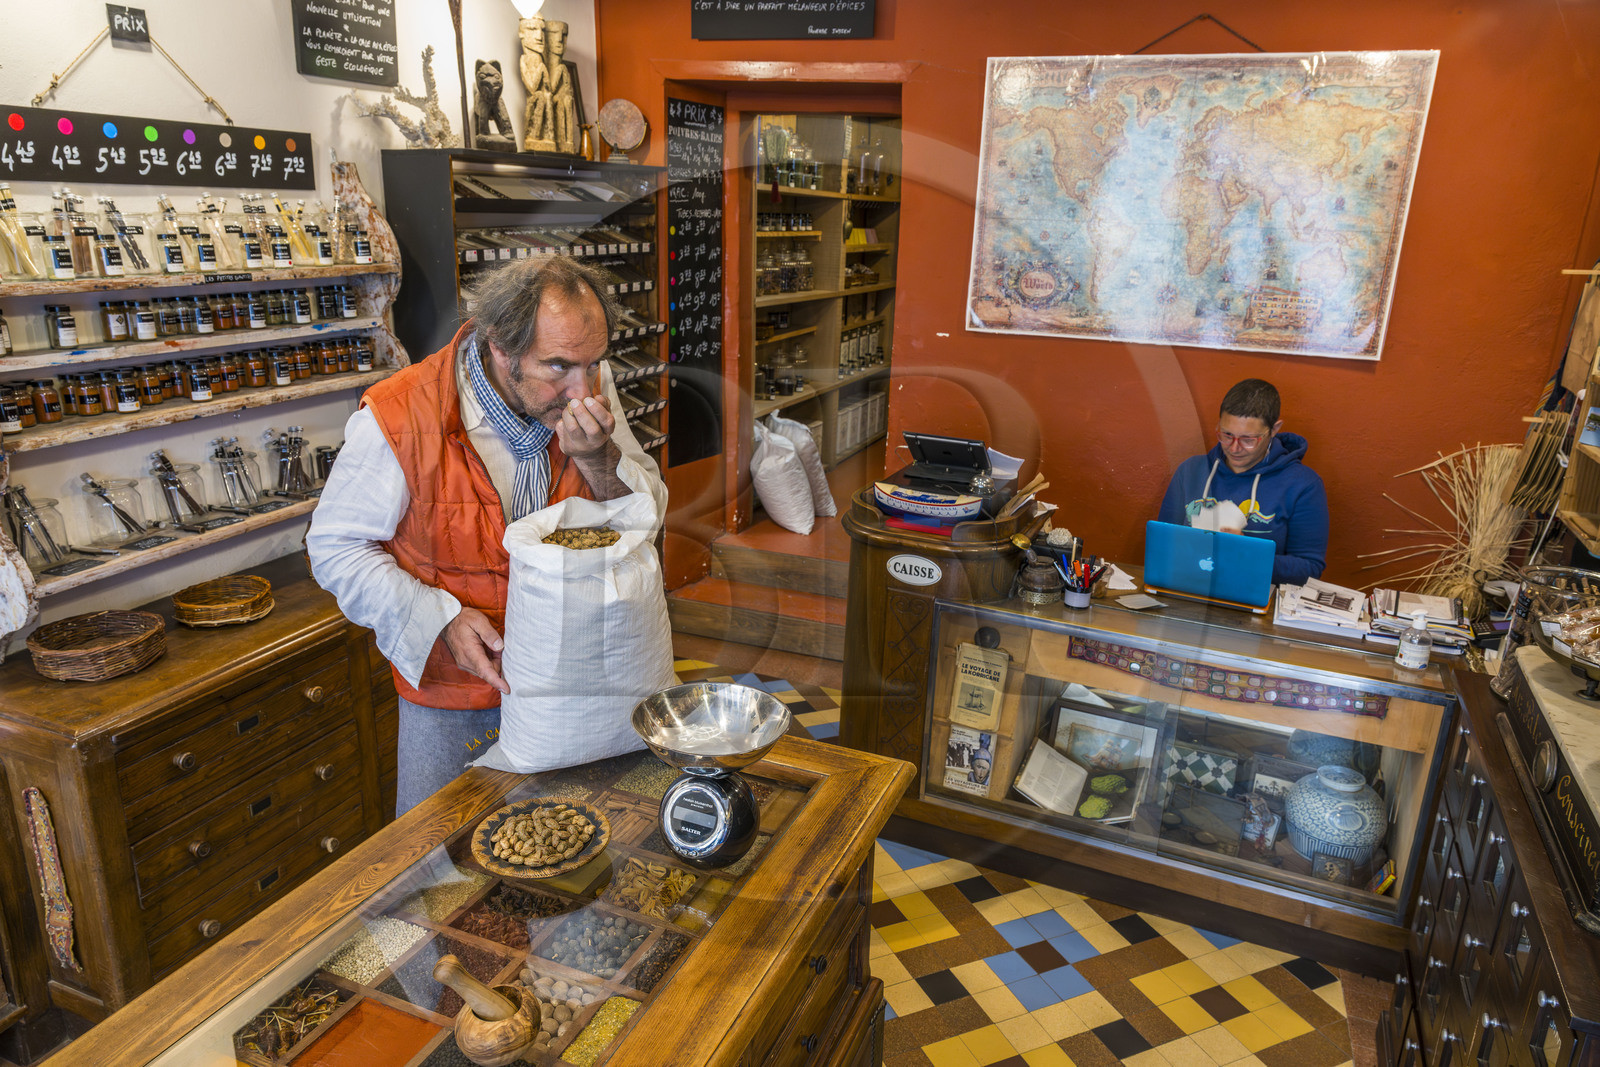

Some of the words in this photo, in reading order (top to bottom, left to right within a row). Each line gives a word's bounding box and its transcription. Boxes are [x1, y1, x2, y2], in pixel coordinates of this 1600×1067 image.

[745, 3, 755, 11] UN
[306, 2, 338, 17] NOUVELLE
[343, 12, 382, 28] UTILISATION
[303, 27, 312, 36] LA
[306, 39, 321, 49] VOUS
[316, 55, 336, 68] GESTE
[344, 58, 384, 75] ÉCOLOGIQUE
[893, 562, 934, 580] CAISSE
[970, 665, 992, 675] VOYAGE
[465, 738, 482, 751] LA
[681, 826, 701, 835] SALTER
